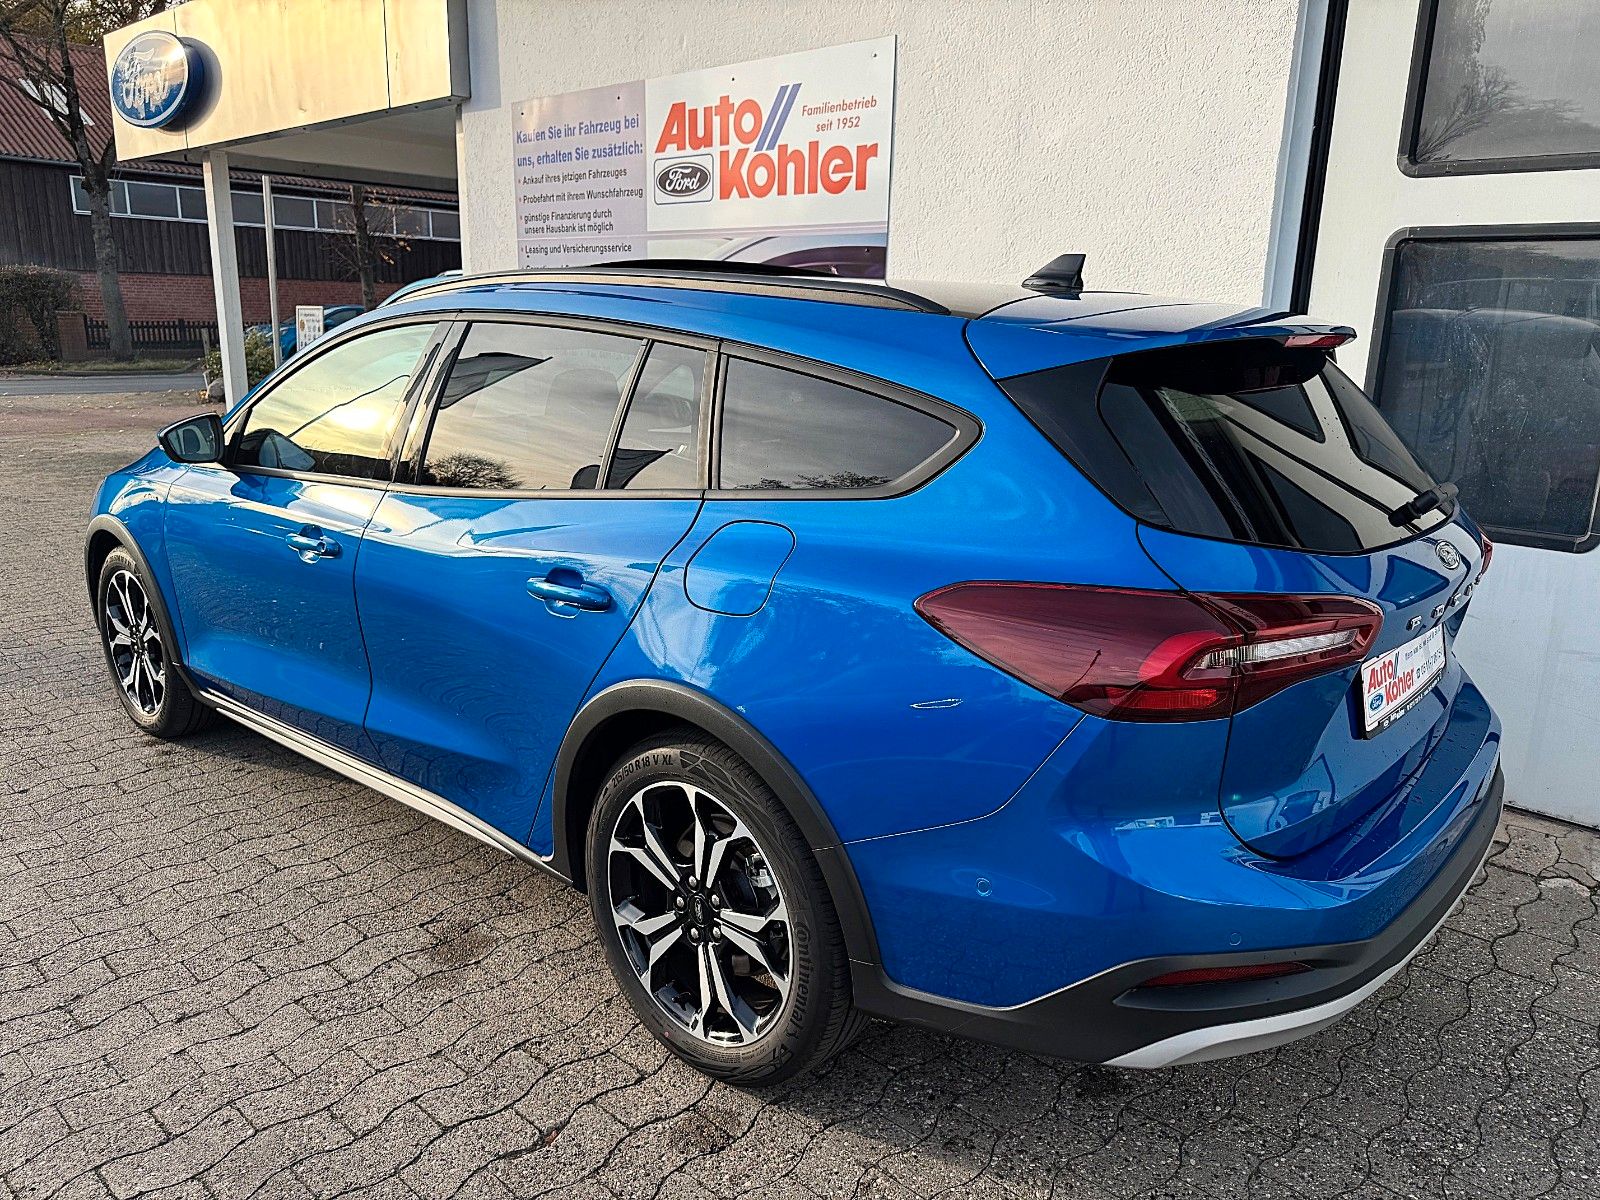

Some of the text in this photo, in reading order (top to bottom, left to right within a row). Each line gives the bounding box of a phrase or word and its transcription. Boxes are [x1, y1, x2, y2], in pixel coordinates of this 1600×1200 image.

[801, 95, 877, 117] Familienbetrieb
[548, 126, 562, 139] Sie
[564, 124, 576, 138] ihr
[578, 119, 621, 136] Fahrzeug
[624, 114, 639, 129] bei
[655, 95, 763, 153] Auto
[816, 115, 861, 132] seit 1952
[517, 140, 643, 168] uns, erhalten Sie zusätzlich:
[522, 168, 627, 185] Ankauf ihres jetzigen Fahrzeuges
[665, 166, 701, 192] Ford
[523, 187, 643, 204] Probefahrt mit ihrem Wunschfahrzeug
[524, 208, 612, 223] günstige Finanzierung durch
[524, 221, 614, 234] unsere Hausbank ist möglich
[525, 242, 632, 255] Leasing und Versicherungsservice
[1368, 659, 1394, 694] Auto
[662, 754, 673, 766] XL
